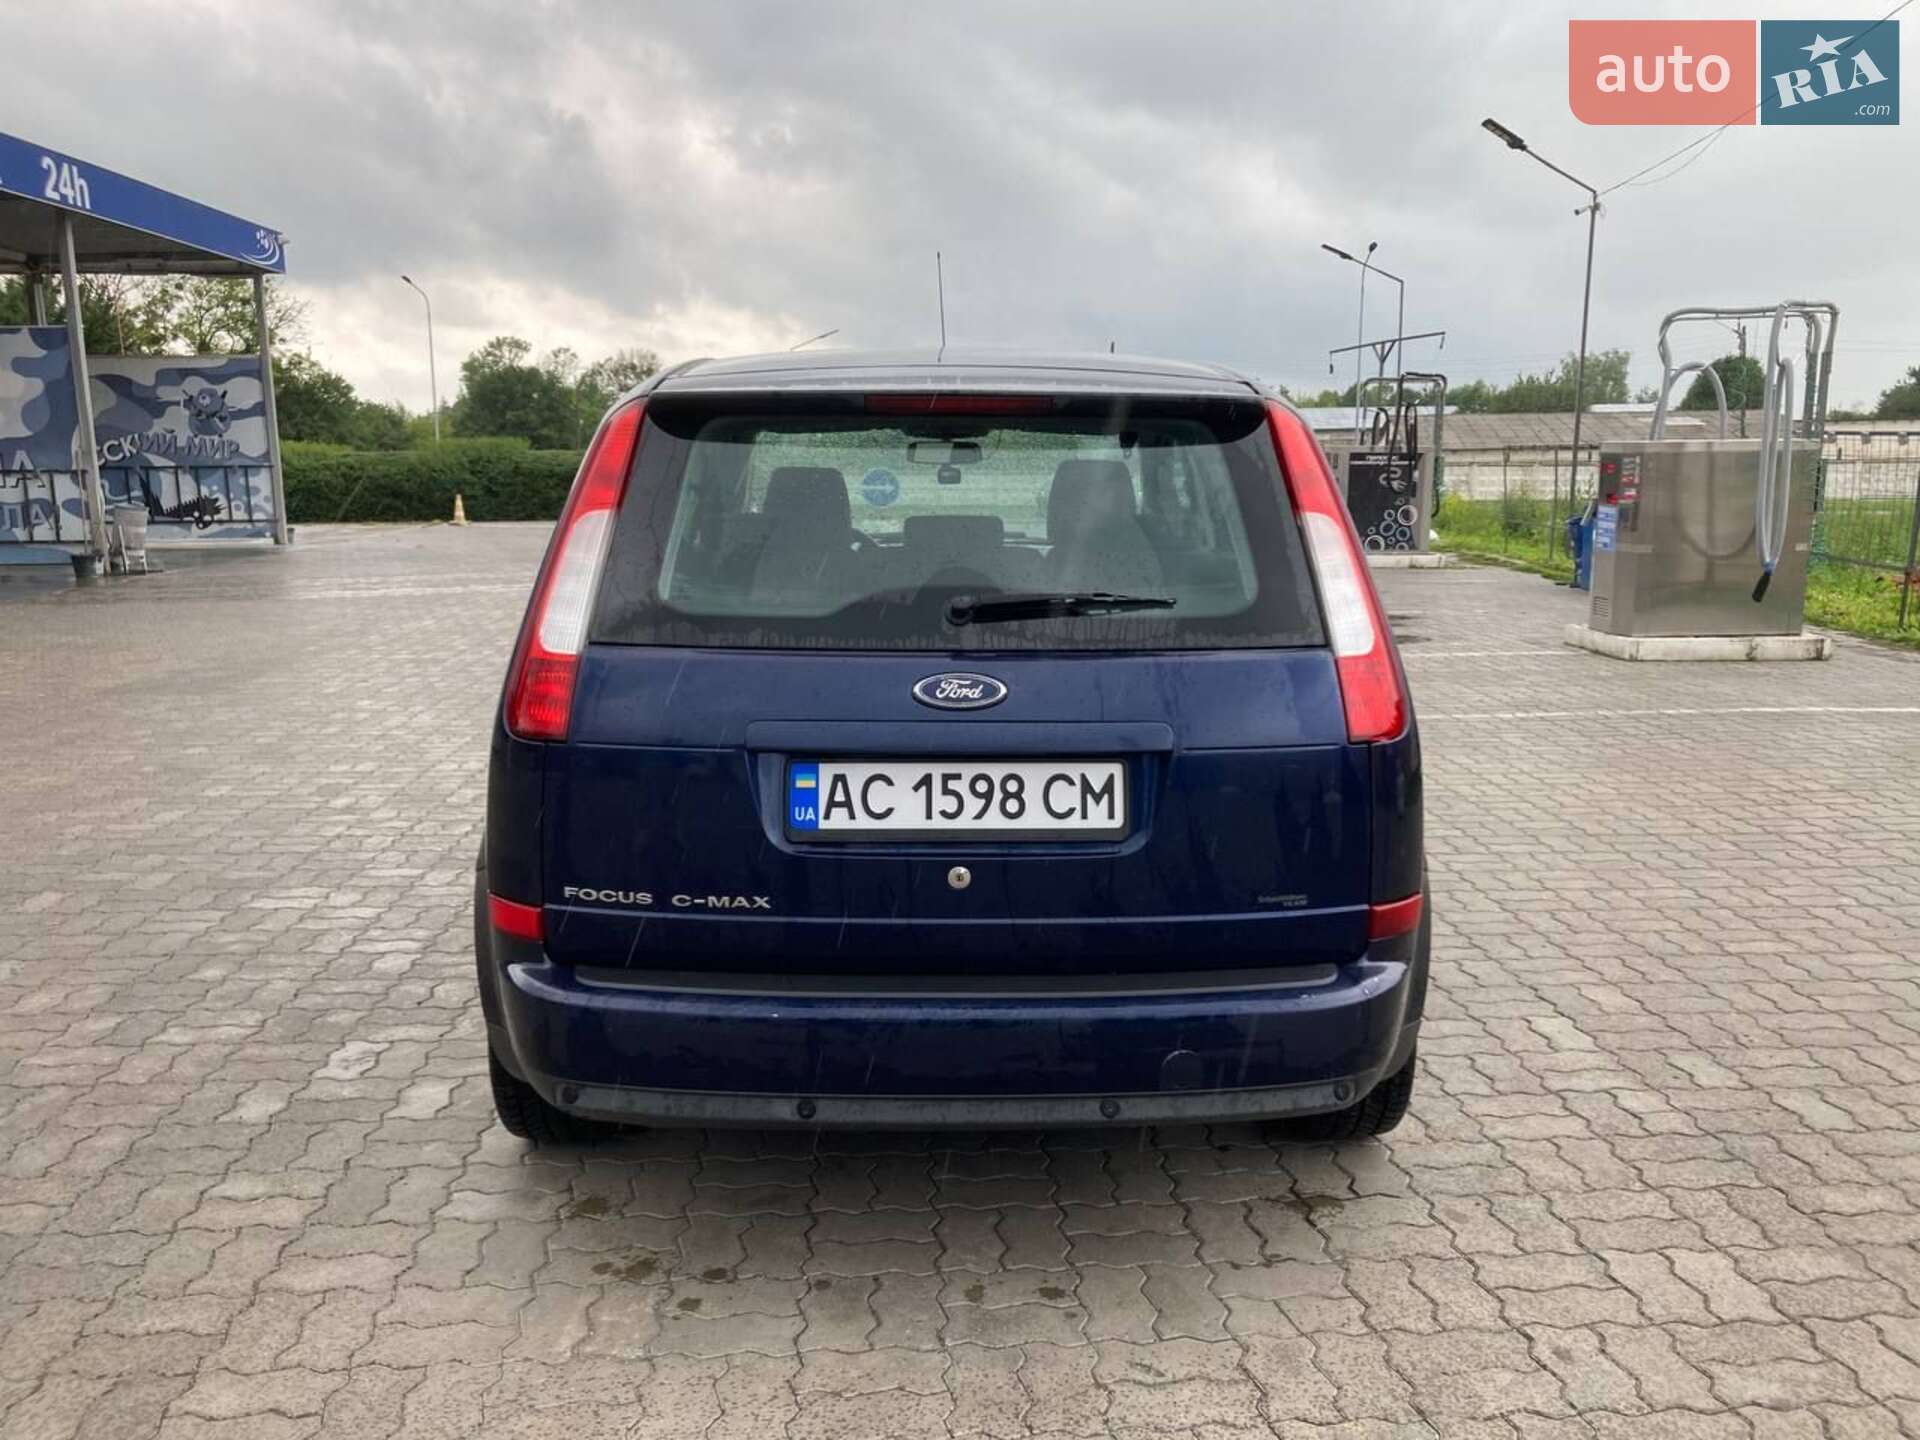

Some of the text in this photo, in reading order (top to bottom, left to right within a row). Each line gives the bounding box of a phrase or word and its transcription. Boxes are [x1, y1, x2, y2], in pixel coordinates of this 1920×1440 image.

[41, 156, 91, 209] 24h
[936, 679, 984, 699] Ford
[823, 773, 1115, 820] AC 1598 CM
[795, 807, 816, 821] UA
[563, 886, 771, 909] FOCUS C-MAX
